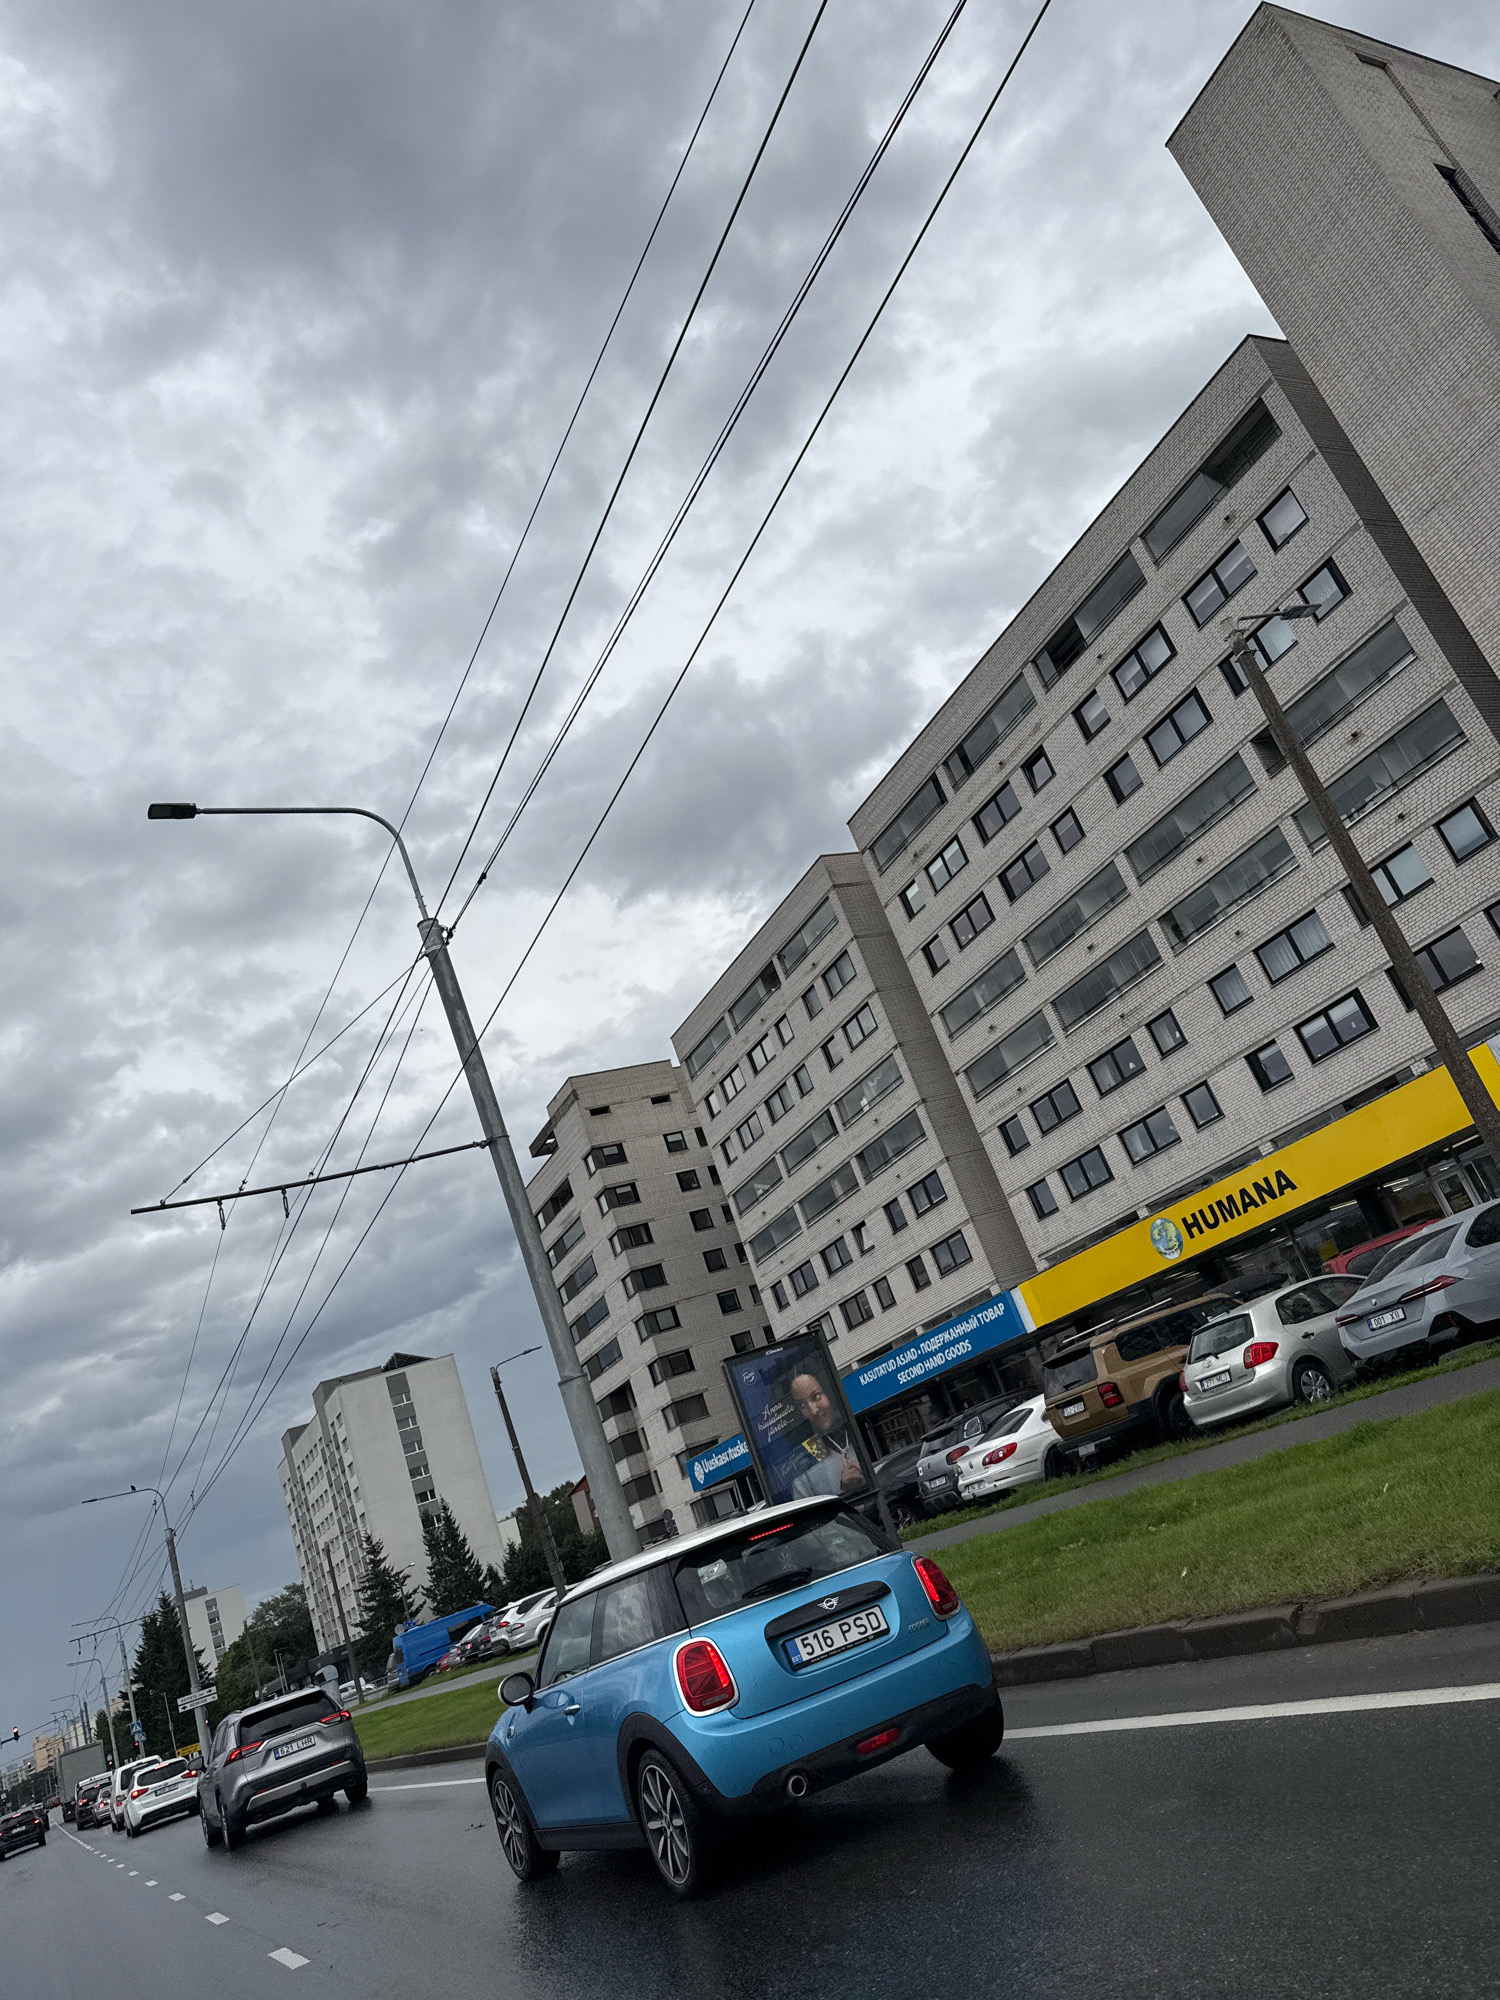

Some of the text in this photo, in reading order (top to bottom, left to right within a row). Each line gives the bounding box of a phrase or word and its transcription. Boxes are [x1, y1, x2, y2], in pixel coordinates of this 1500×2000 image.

[1181, 1169, 1298, 1240] HUMANA
[859, 1302, 1005, 1386] KASUTATUD ASJAD ПОДЕРЖАННЫЙ ТОВАР
[897, 1339, 972, 1385] SECOND HAND GOODS
[761, 1402, 783, 1421] Anna
[801, 1629, 834, 1657] 516
[838, 1611, 882, 1643] PSD
[791, 1654, 802, 1664] EST
[279, 1736, 314, 1756] 621 LHR
